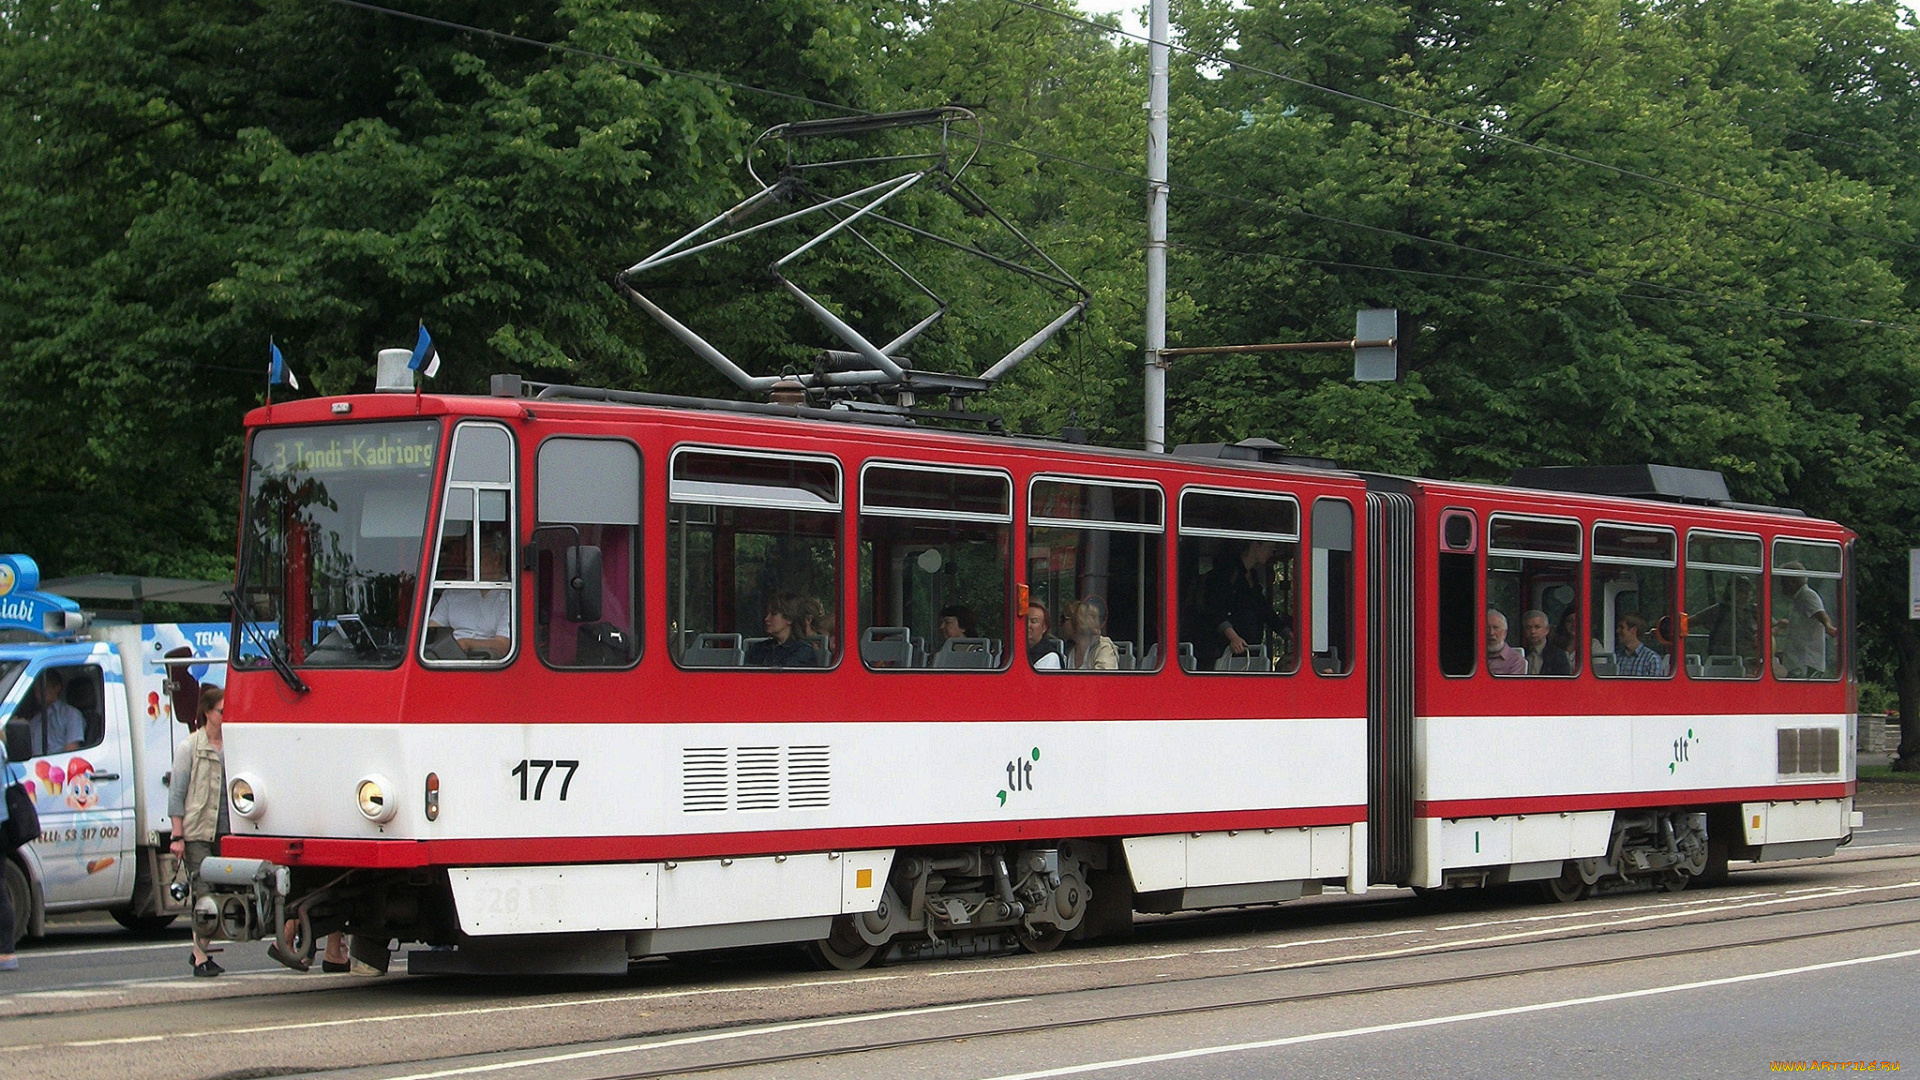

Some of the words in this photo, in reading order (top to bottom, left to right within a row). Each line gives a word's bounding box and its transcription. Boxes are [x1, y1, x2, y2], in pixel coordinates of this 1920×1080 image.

[275, 443, 286, 470] 3
[294, 436, 433, 469] Tondi-Kadriorg
[0, 597, 35, 622] iabi
[511, 759, 580, 801] 177
[1006, 756, 1033, 791] tlt
[65, 829, 77, 841] 53
[100, 826, 119, 838] 002
